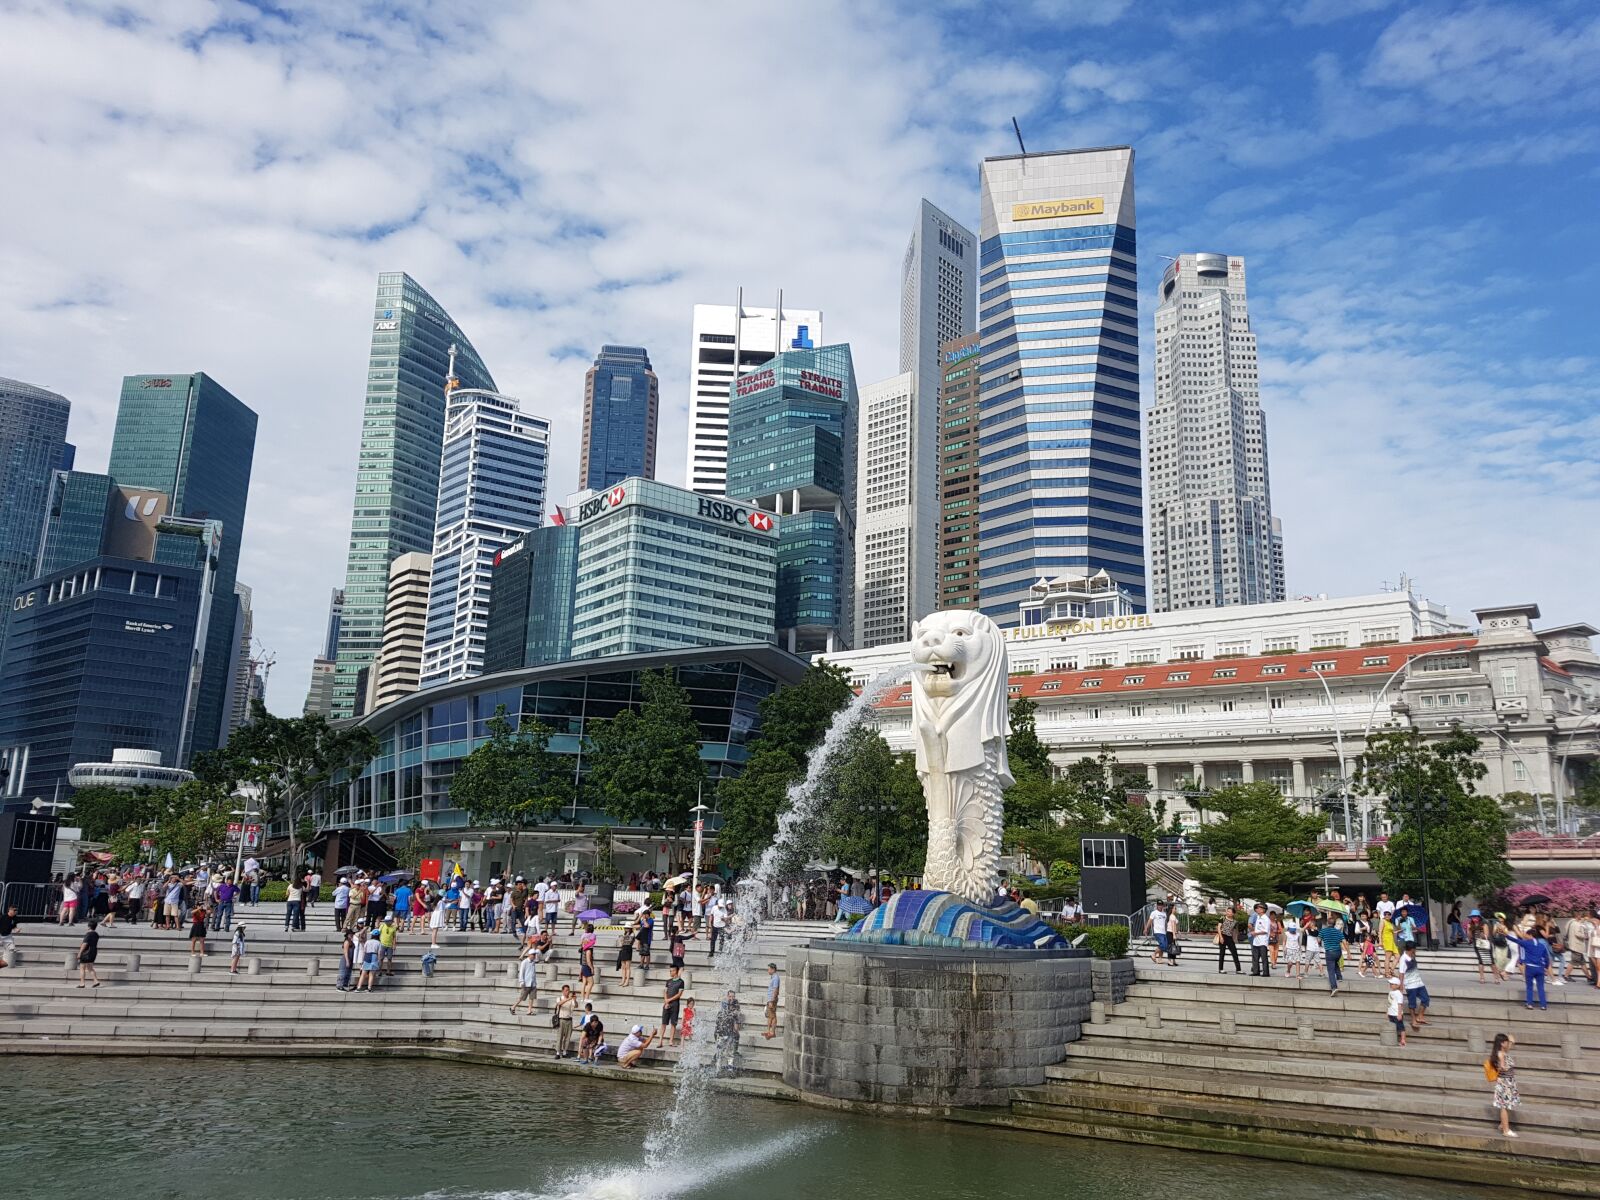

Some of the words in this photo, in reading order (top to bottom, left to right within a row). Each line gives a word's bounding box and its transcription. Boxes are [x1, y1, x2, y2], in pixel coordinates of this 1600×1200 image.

[1031, 200, 1095, 216] Maybank
[736, 368, 774, 387] STRAITS
[800, 370, 842, 388] STRAITS
[736, 378, 775, 397] TRADING
[799, 379, 842, 399] TRADING
[578, 493, 609, 522] HSBC
[697, 497, 747, 526] HSBC
[13, 592, 36, 611] OUE
[1013, 622, 1094, 640] FULLERTON
[1101, 615, 1153, 631] HOTEL
